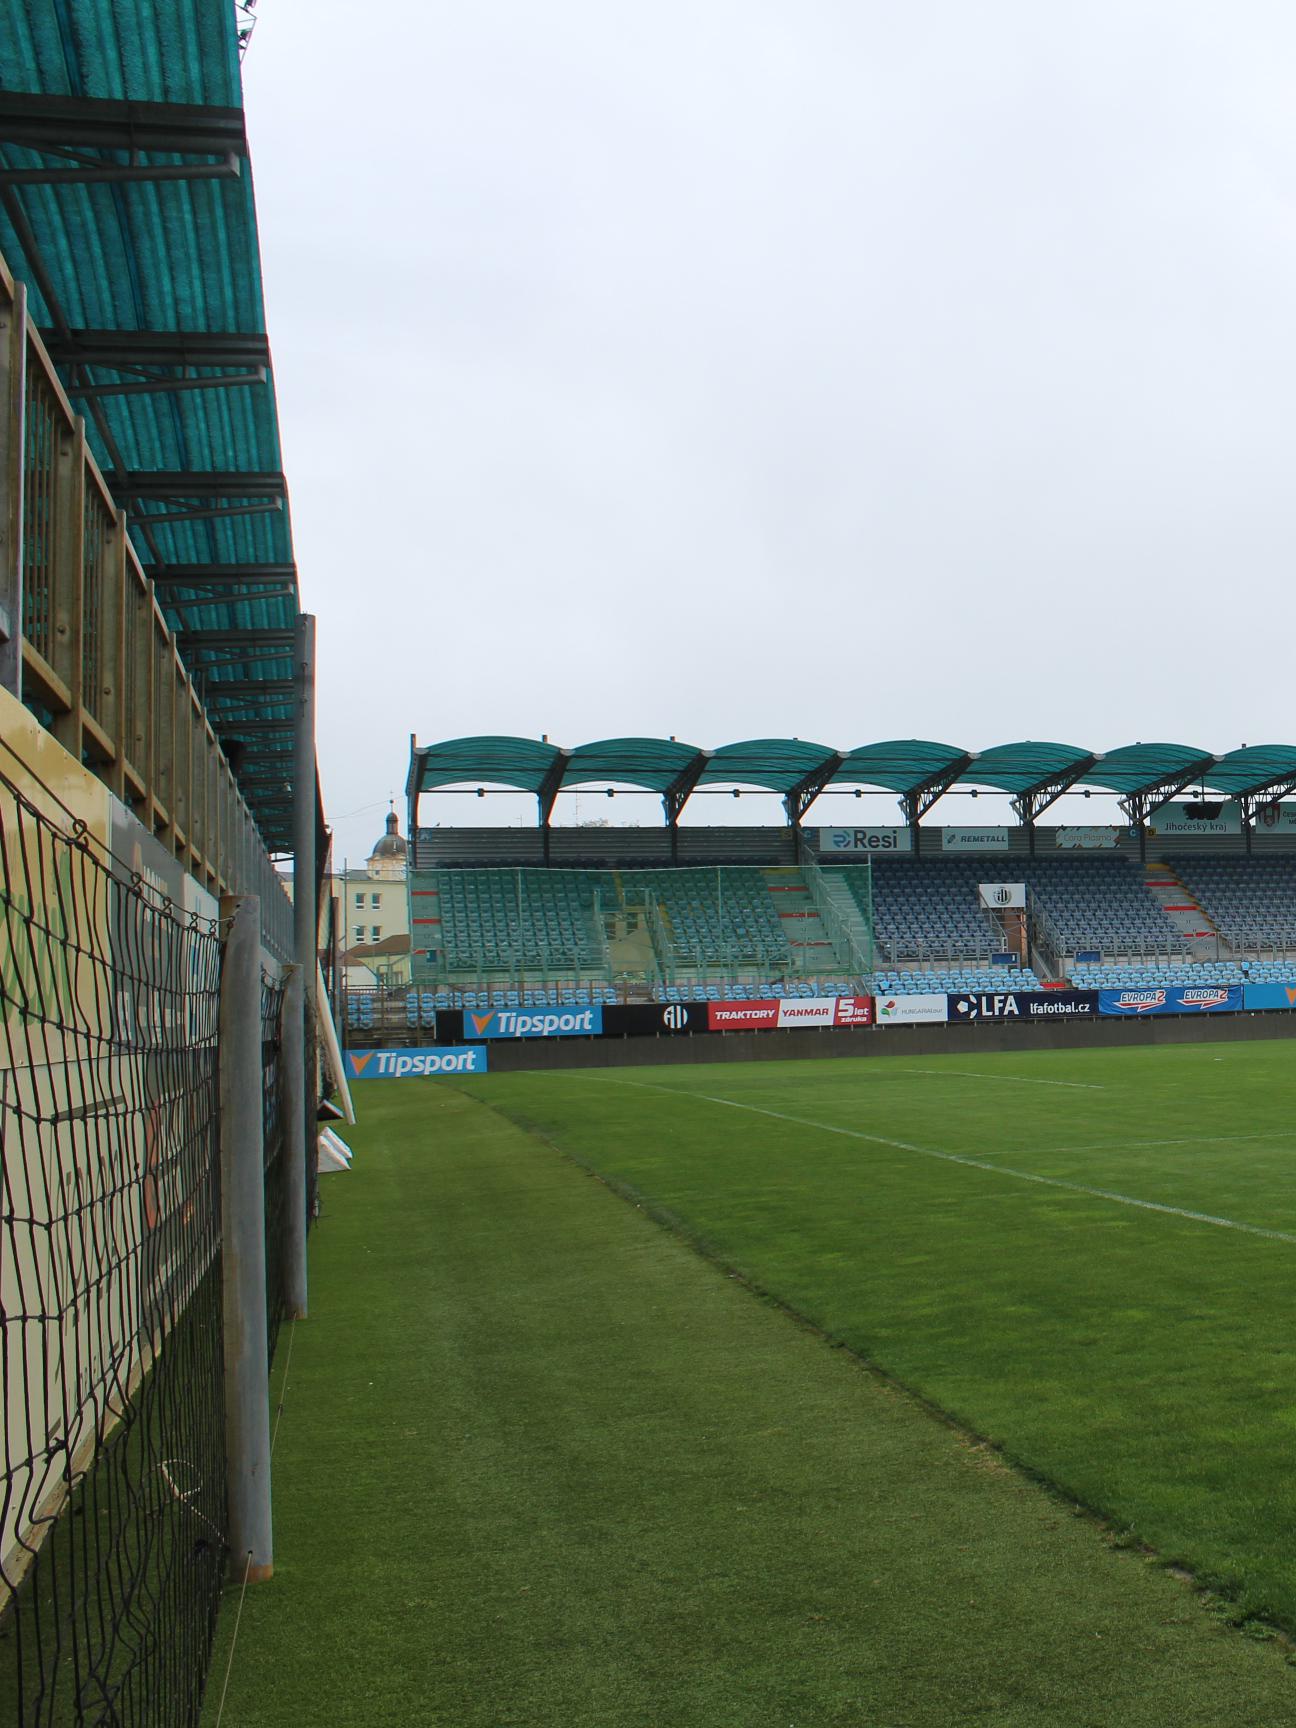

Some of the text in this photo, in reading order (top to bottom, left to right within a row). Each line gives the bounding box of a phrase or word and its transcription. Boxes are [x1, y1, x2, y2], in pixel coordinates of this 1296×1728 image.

[1165, 822, 1227, 832] Jihočeský kraj
[853, 829, 898, 849] Resi
[960, 835, 1007, 843] REMETALL
[782, 1007, 829, 1017] YANMAR
[837, 998, 870, 1017] 5 let
[981, 995, 1020, 1016] LFA
[1030, 1001, 1091, 1015] lfafotbal.cz
[714, 1008, 776, 1020] TRAKTORY
[497, 1009, 595, 1037] Tipsport
[376, 1050, 477, 1078] Tipsport
